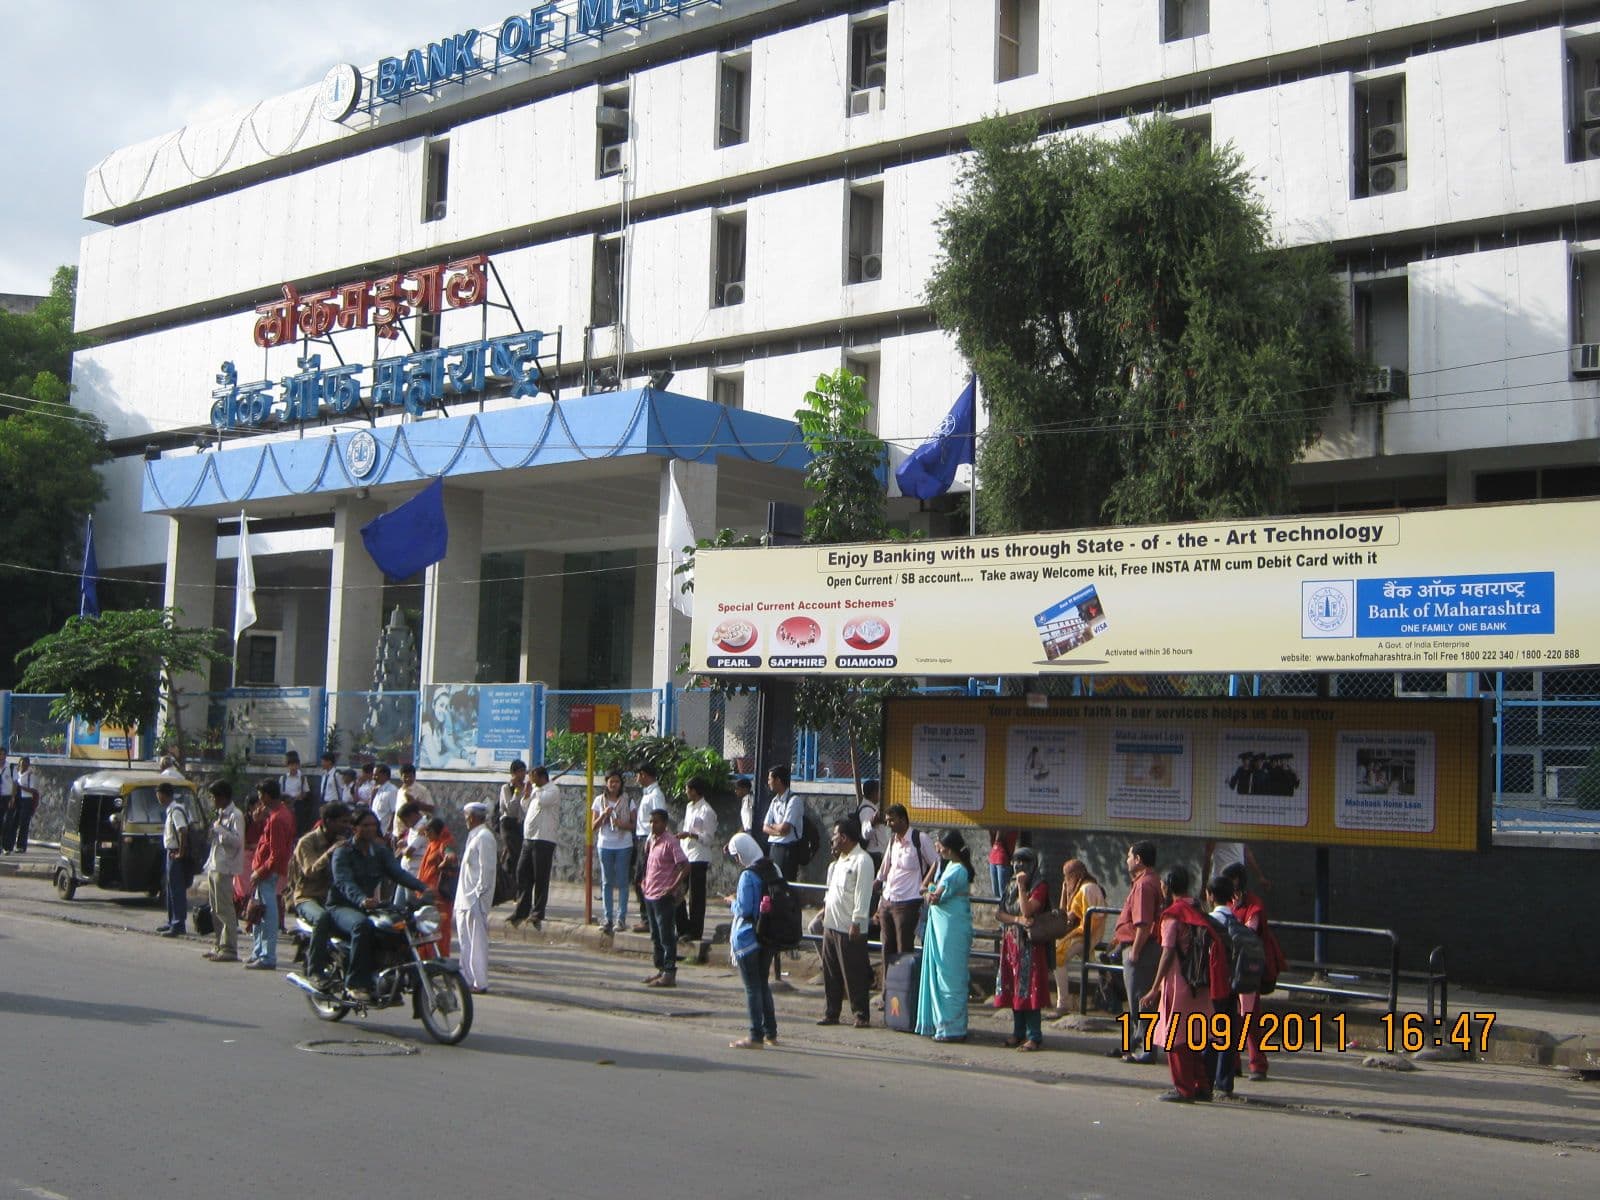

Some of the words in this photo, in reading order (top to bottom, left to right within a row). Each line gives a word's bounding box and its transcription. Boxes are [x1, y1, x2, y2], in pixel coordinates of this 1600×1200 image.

[377, 28, 480, 98] BANK
[499, 4, 557, 56] OF
[372, 329, 544, 416] महाराष्ट्र
[828, 551, 868, 568] Enjoy
[873, 546, 935, 565] Banking
[941, 545, 975, 560] with
[980, 547, 1000, 558] us
[1005, 540, 1070, 559] through
[1076, 537, 1124, 553] State
[1141, 535, 1159, 550] of
[1178, 532, 1208, 548] the
[1226, 528, 1257, 545] Art
[1264, 523, 1384, 543] Technology
[827, 576, 852, 589] Open
[855, 574, 892, 586] Current
[901, 572, 915, 584] SB
[980, 569, 1006, 581] Take
[1009, 569, 1039, 583] away
[1043, 565, 1095, 579] Welcome
[1098, 564, 1118, 578] kit,
[1121, 562, 1147, 576] Free
[1151, 560, 1190, 574] INSTA
[1193, 558, 1221, 572] ATM
[1225, 559, 1252, 570] cum
[1257, 555, 1292, 569] Debit
[1296, 553, 1328, 567] Card
[1332, 551, 1363, 566] with
[1367, 551, 1377, 565] it
[1383, 580, 1413, 598] बैंक
[1417, 579, 1456, 598] ऑफ
[1460, 580, 1526, 598] महाराष्ट्र
[718, 602, 754, 614] Special
[757, 602, 795, 611] Current
[798, 600, 841, 610] Account
[1368, 604, 1409, 619] Bank
[1413, 603, 1431, 617] of
[1434, 600, 1541, 617] Maharashtra
[1400, 624, 1419, 633] ONE
[1422, 623, 1454, 632] FAMILY
[1458, 623, 1478, 632] ONE
[1480, 622, 1507, 631] BANK
[1104, 648, 1137, 657] Activated
[1139, 647, 1160, 656] within
[1162, 647, 1170, 655] 36
[1172, 647, 1193, 655] hours
[1405, 641, 1413, 649] of
[1433, 640, 1470, 649] Enterprise
[717, 658, 751, 667] PEARL
[770, 658, 825, 667] SAPPHIRE
[839, 658, 894, 667] DIAMOND
[1280, 653, 1311, 663] website:
[1316, 651, 1421, 663] www.bankofmaharashtra.in
[1424, 651, 1438, 661] Toll
[1440, 651, 1458, 661] Free
[1461, 650, 1480, 660] 1800
[1483, 650, 1497, 660] 222
[1499, 650, 1514, 660] 340
[1522, 649, 1541, 660] 1800
[1564, 648, 1580, 659] 888
[989, 704, 1011, 719] Your
[1084, 705, 1111, 719] faith
[1156, 706, 1208, 721] services
